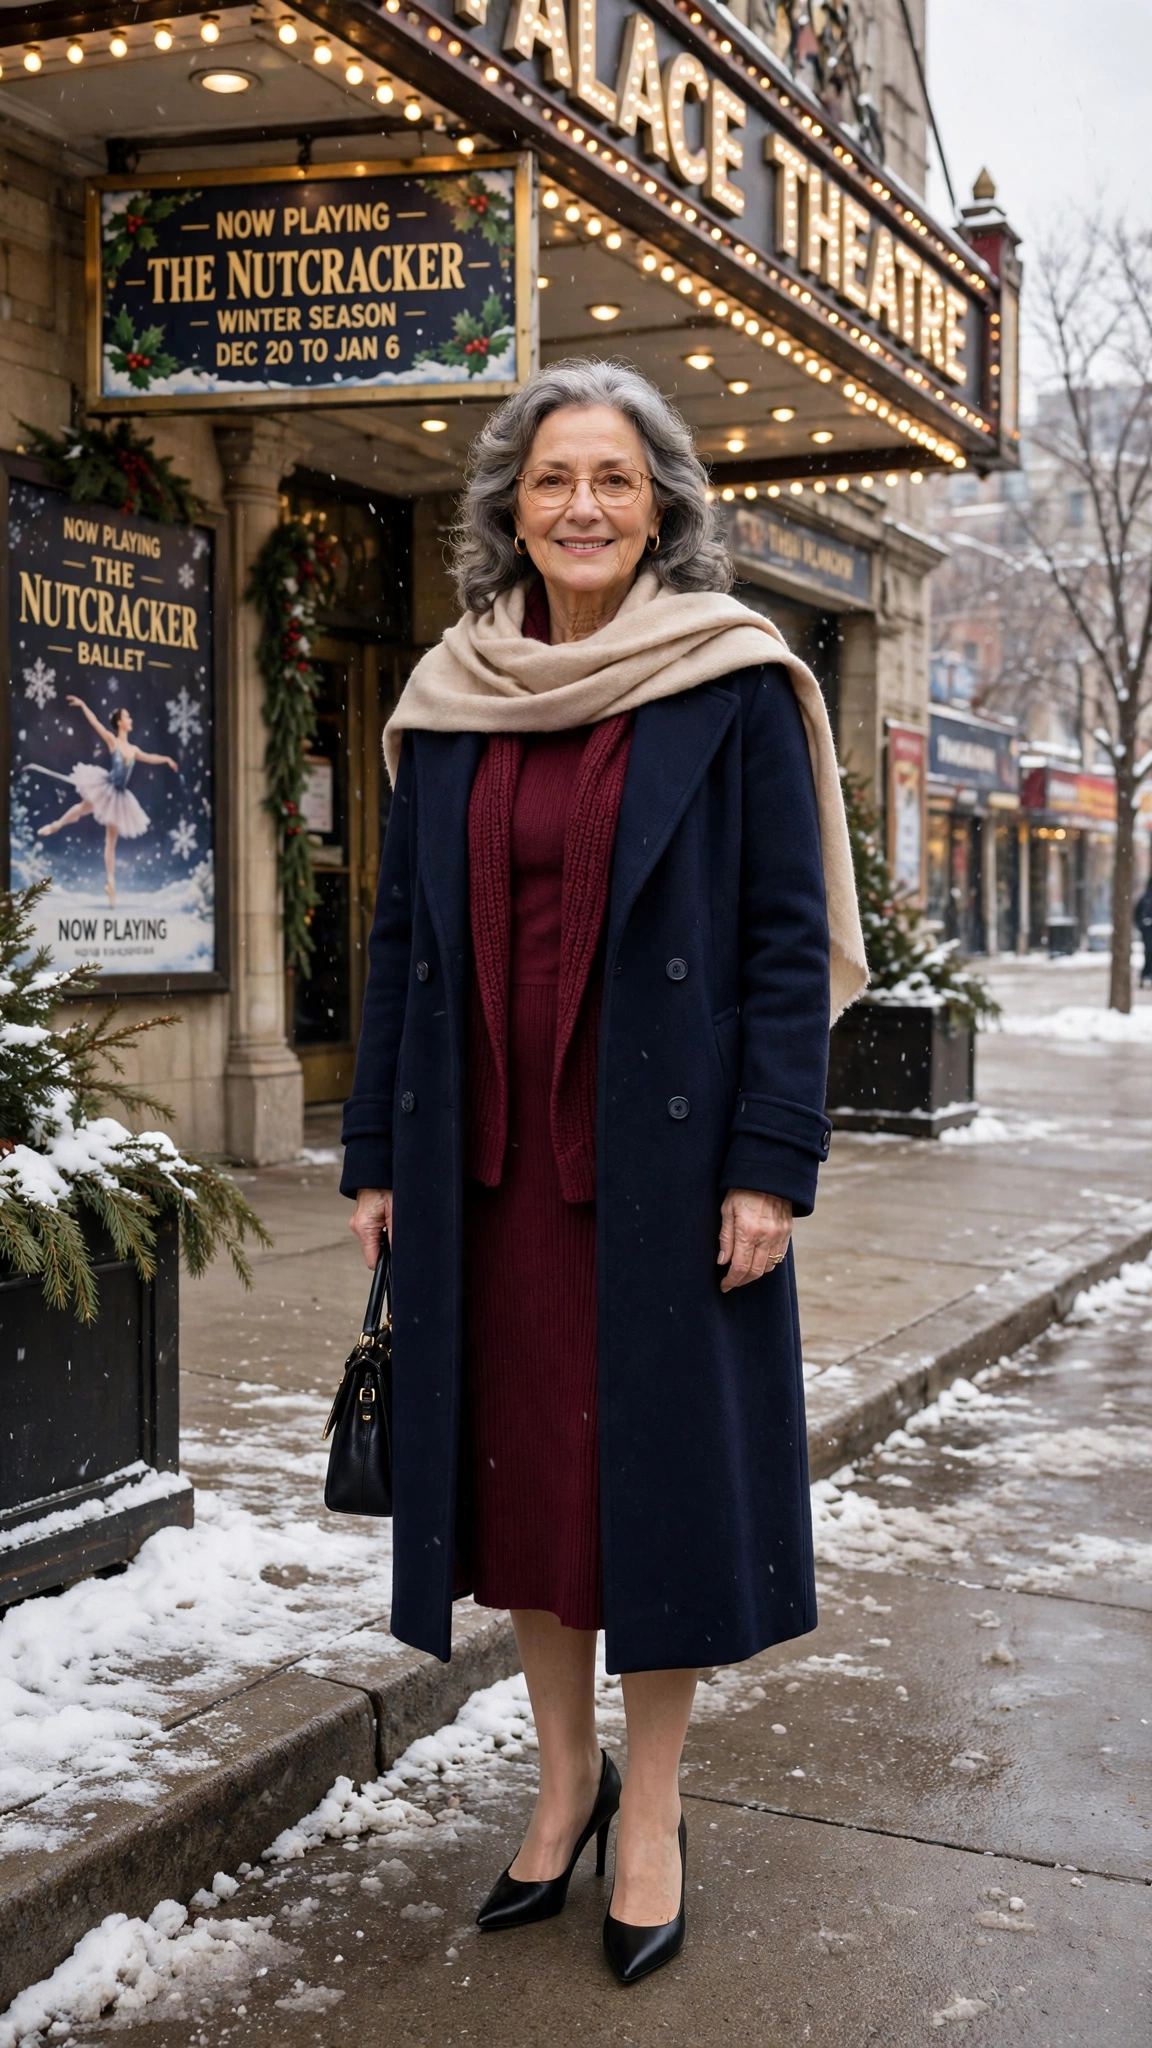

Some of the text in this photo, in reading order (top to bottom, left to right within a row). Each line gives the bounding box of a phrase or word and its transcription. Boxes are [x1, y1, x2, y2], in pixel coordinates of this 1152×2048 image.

[452, 0, 967, 387] ALACE THEATRE
[216, 202, 390, 240] NOW PLAYING
[147, 242, 465, 303] THE NUTCRACKER
[217, 302, 397, 334] WINTER SEASON
[216, 334, 400, 367] DEC 20 TO JAN 6
[63, 516, 161, 559] NOW PLAYING
[91, 555, 135, 589] THE
[19, 571, 199, 651] NUTCRACKER
[77, 640, 146, 672] BALLET
[58, 918, 167, 941] NOW PLAYING
